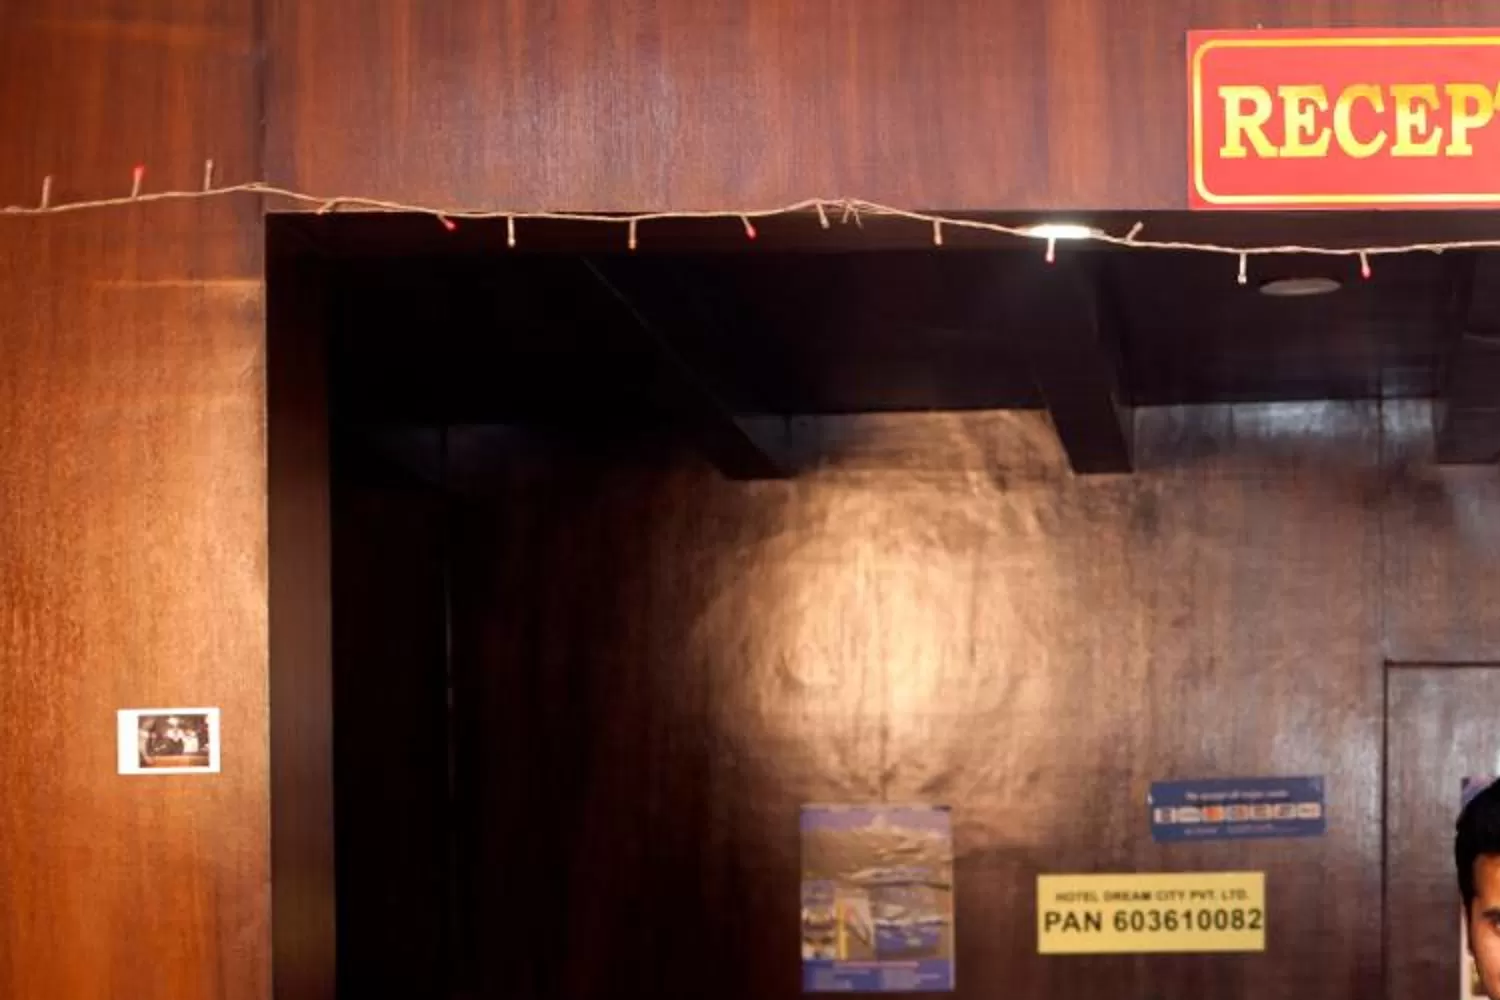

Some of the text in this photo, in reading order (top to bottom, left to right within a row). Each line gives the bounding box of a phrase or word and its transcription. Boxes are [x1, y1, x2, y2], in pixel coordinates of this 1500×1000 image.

[1055, 890, 1099, 902] HOTEL
[1103, 889, 1152, 901] DREAM
[1156, 889, 1185, 901] CITY
[1220, 888, 1249, 900] LTD.
[1044, 908, 1263, 932] PAN 603610082
